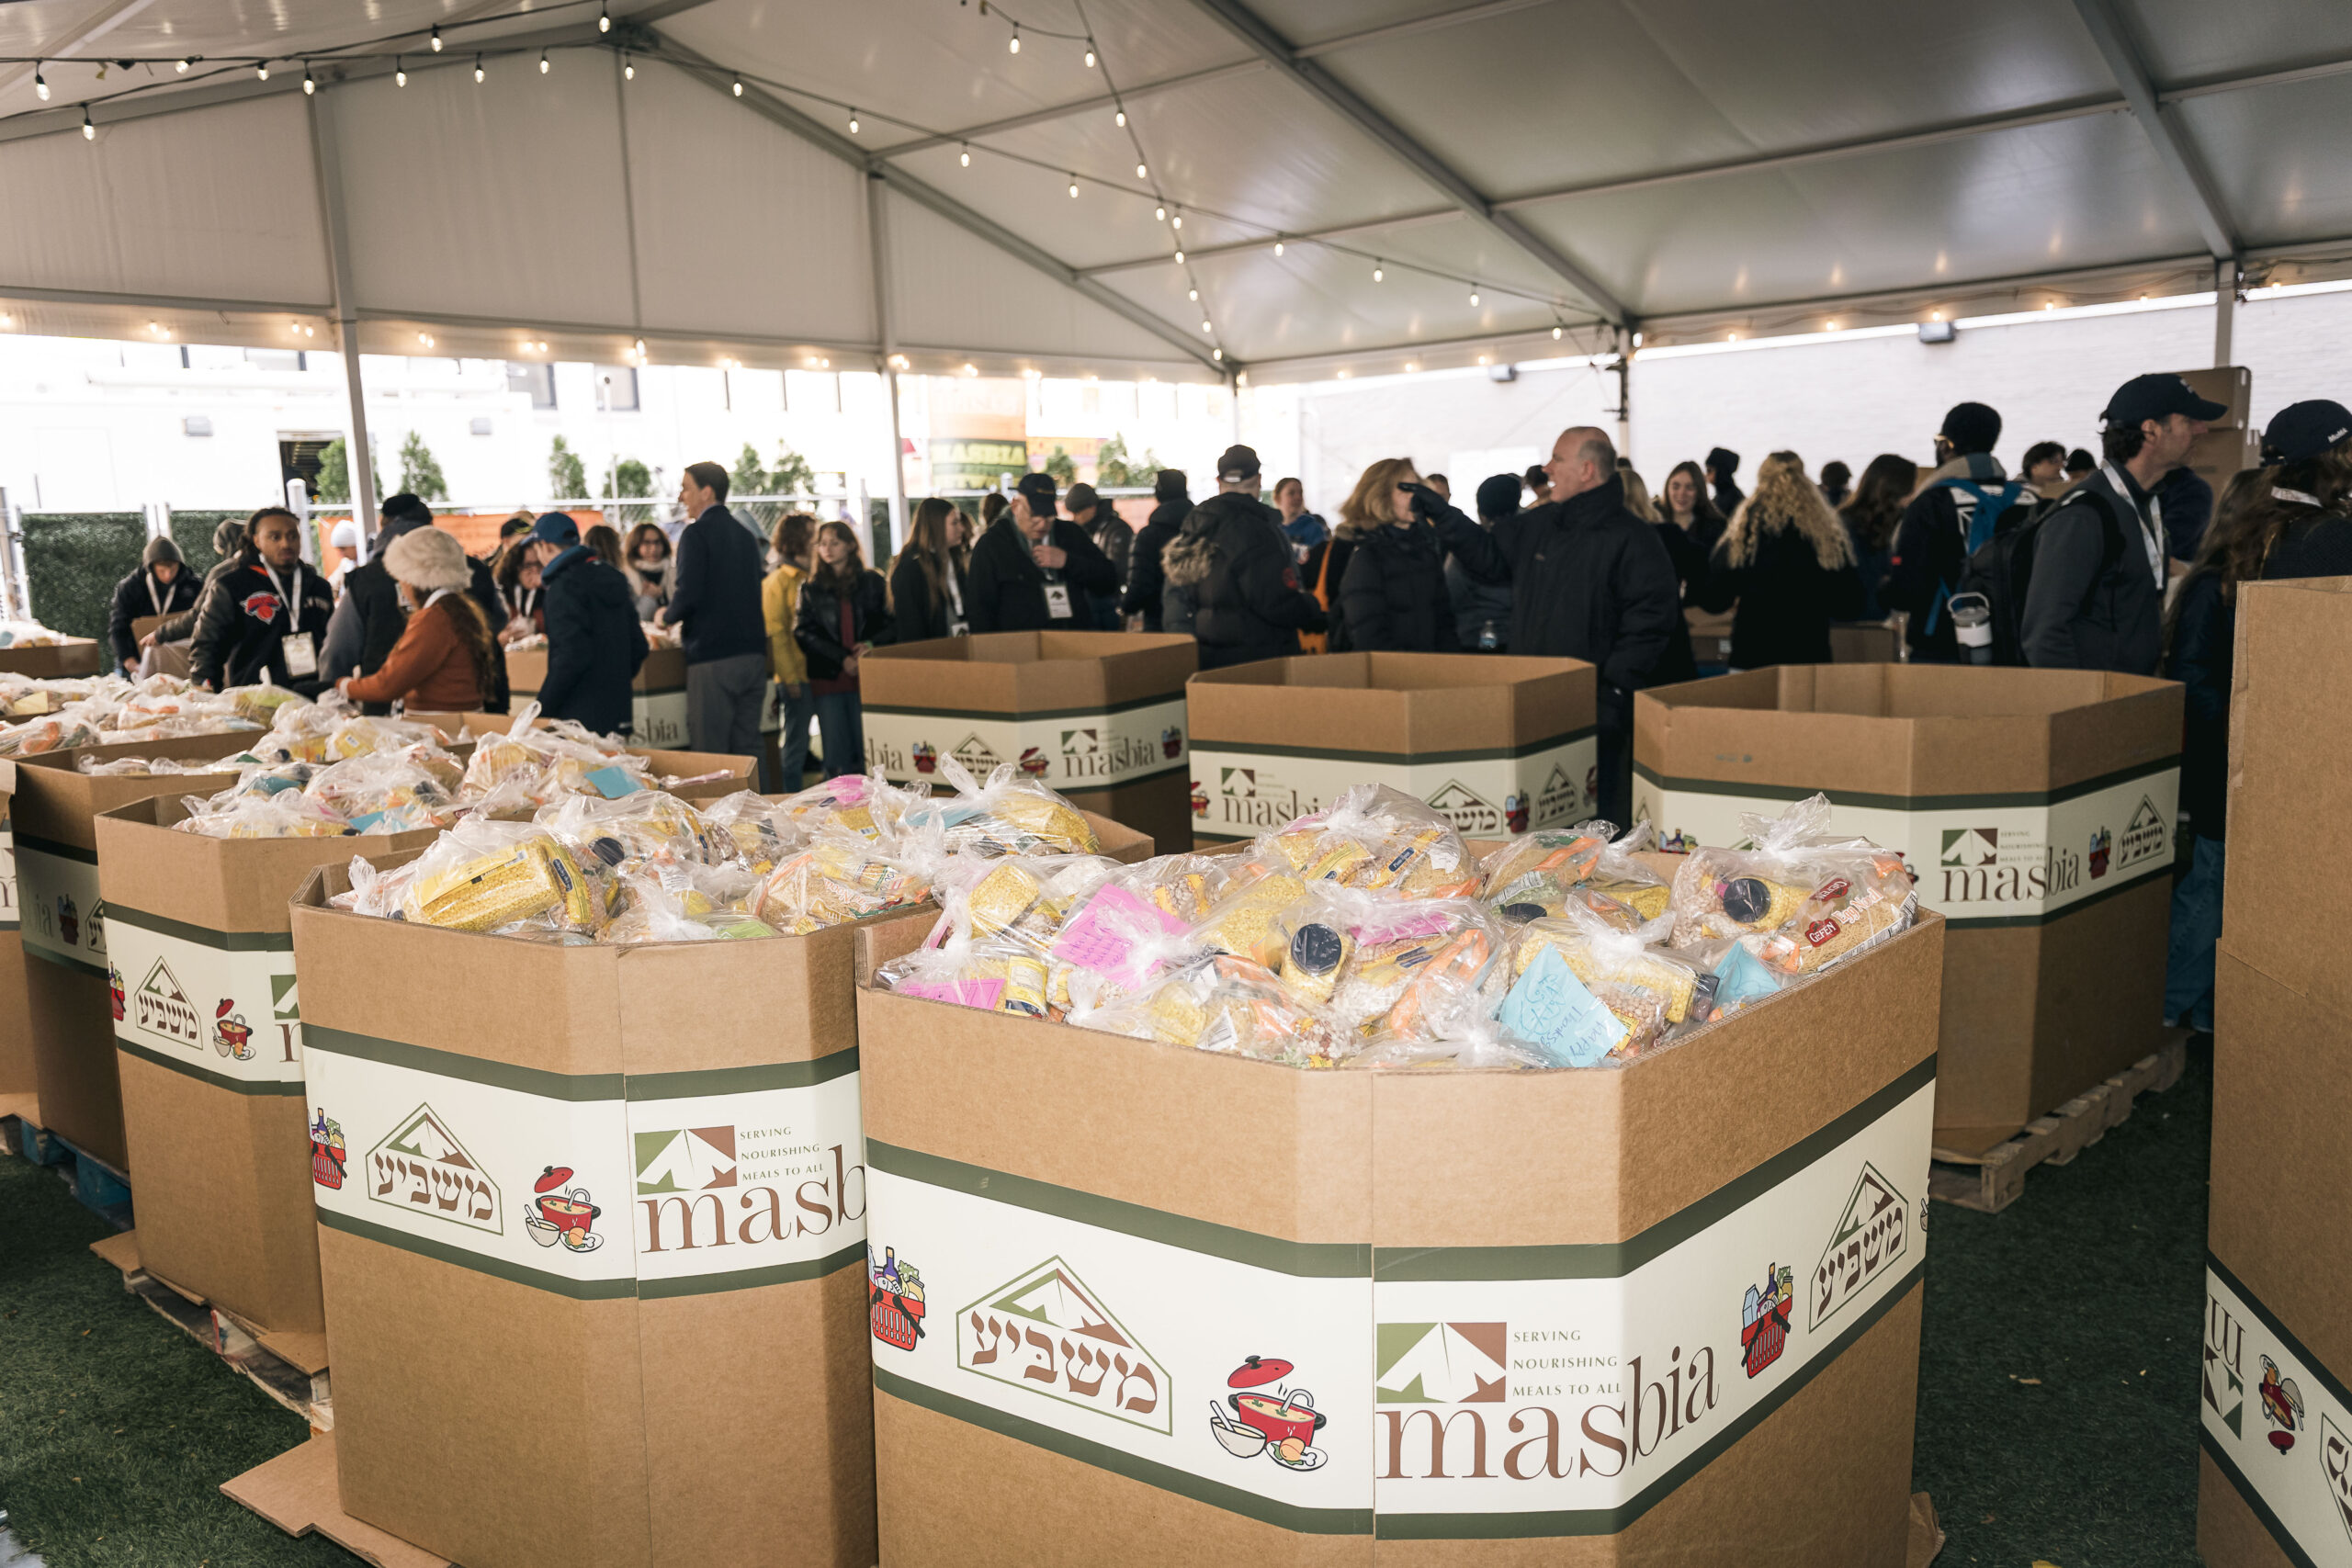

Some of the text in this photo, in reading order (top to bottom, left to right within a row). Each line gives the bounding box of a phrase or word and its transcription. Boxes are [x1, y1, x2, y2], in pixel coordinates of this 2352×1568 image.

[1065, 739, 1156, 778] masbia
[1223, 790, 1319, 827] masbi
[1939, 846, 2080, 904] masbia
[1809, 921, 1837, 942] GEFEN
[1831, 906, 1860, 924] Egg
[740, 1126, 792, 1140] SERVING
[741, 1144, 820, 1160] NOURISHING
[742, 1163, 824, 1181] MEALS TO ALL
[638, 1144, 866, 1254] masb
[1513, 1329, 1581, 1343] SERVING
[1513, 1356, 1618, 1370] NOURISHING
[1512, 1382, 1623, 1397] MEALS TO ALL
[1375, 1346, 1720, 1481] masbia
